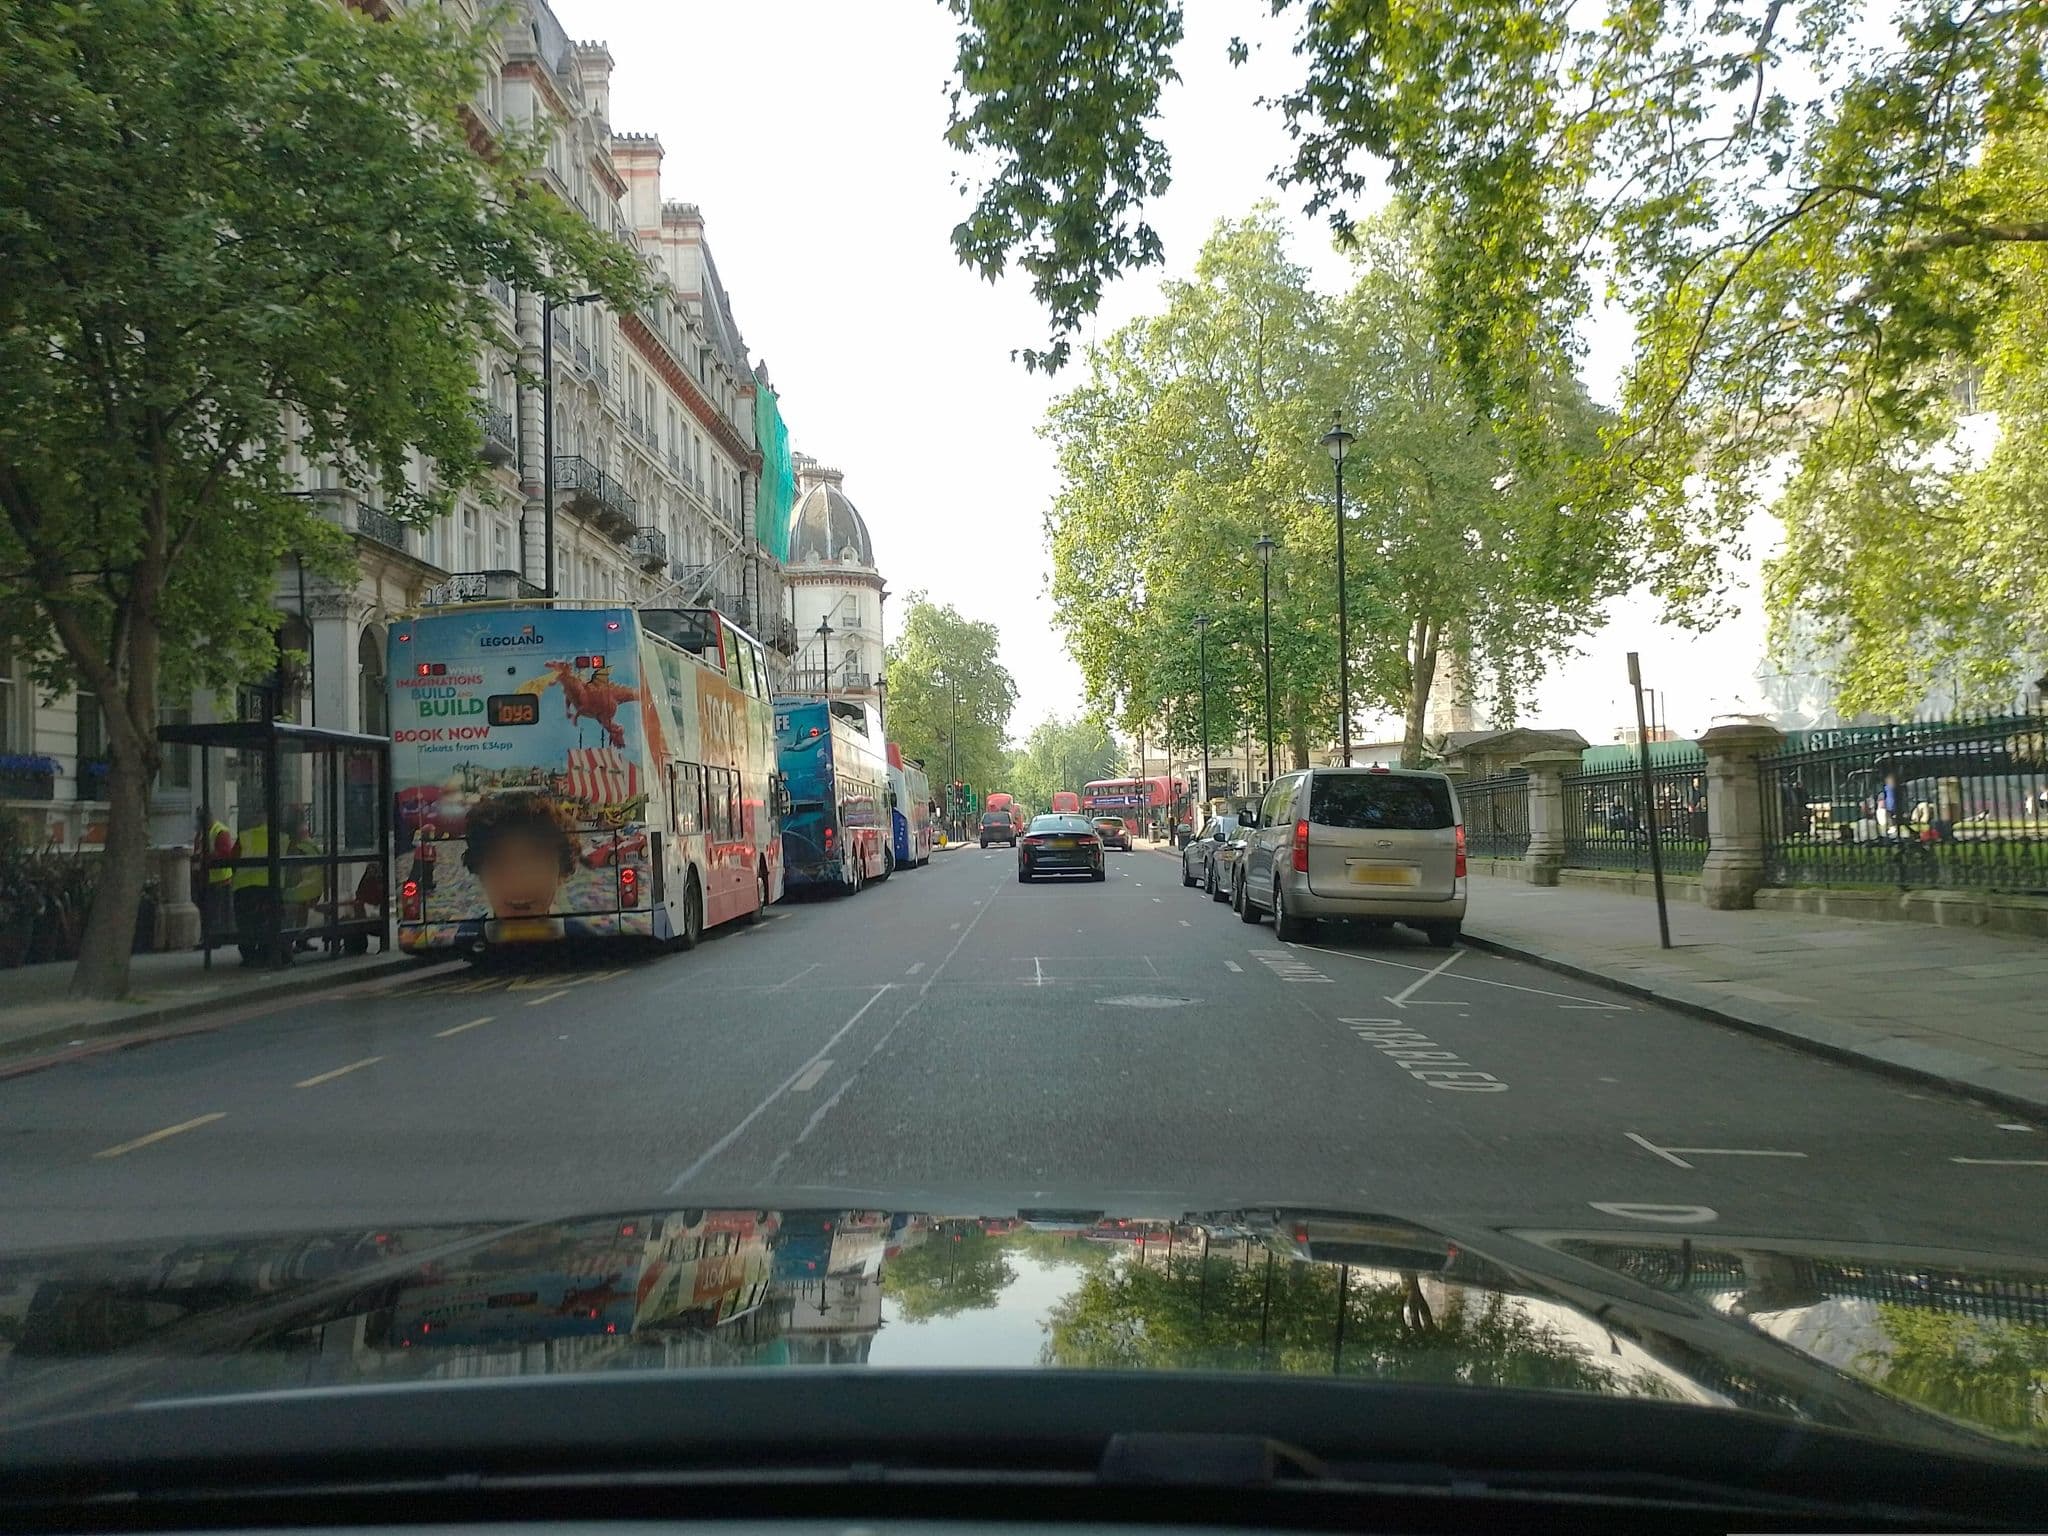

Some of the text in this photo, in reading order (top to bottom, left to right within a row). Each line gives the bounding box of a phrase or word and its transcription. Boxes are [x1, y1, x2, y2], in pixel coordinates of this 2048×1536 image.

[480, 625, 544, 647] LEGOLAND
[396, 675, 483, 688] IMAGINATIONS
[411, 687, 456, 700] BUILD
[420, 698, 485, 717] BUILD
[394, 726, 491, 743] BOOK NOW
[416, 741, 513, 753] Tickets from £34pp
[1337, 1017, 1510, 1092] DISABLED
